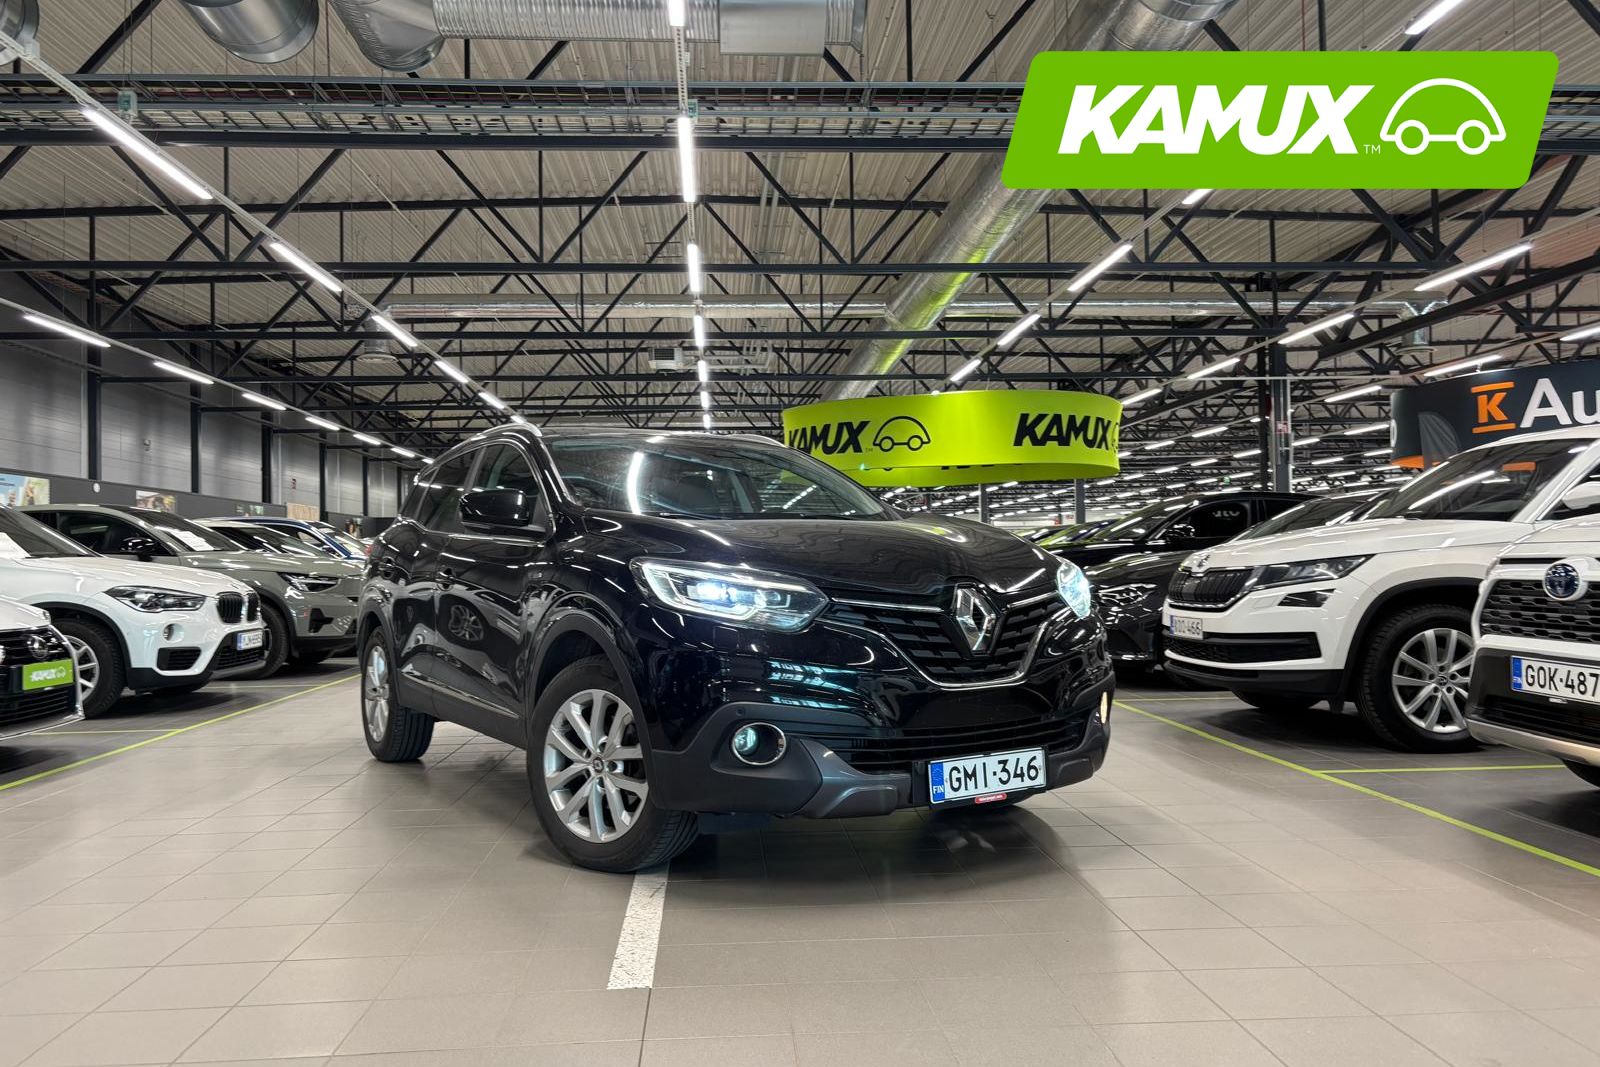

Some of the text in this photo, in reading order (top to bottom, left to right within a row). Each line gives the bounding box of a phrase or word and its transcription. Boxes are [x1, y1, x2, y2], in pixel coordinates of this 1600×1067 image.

[788, 420, 871, 455] KAMUX
[1013, 412, 1111, 450] KAMUX
[1525, 664, 1600, 697] GOK-487
[932, 784, 945, 794] FIN
[948, 755, 1039, 793] GMI-346
